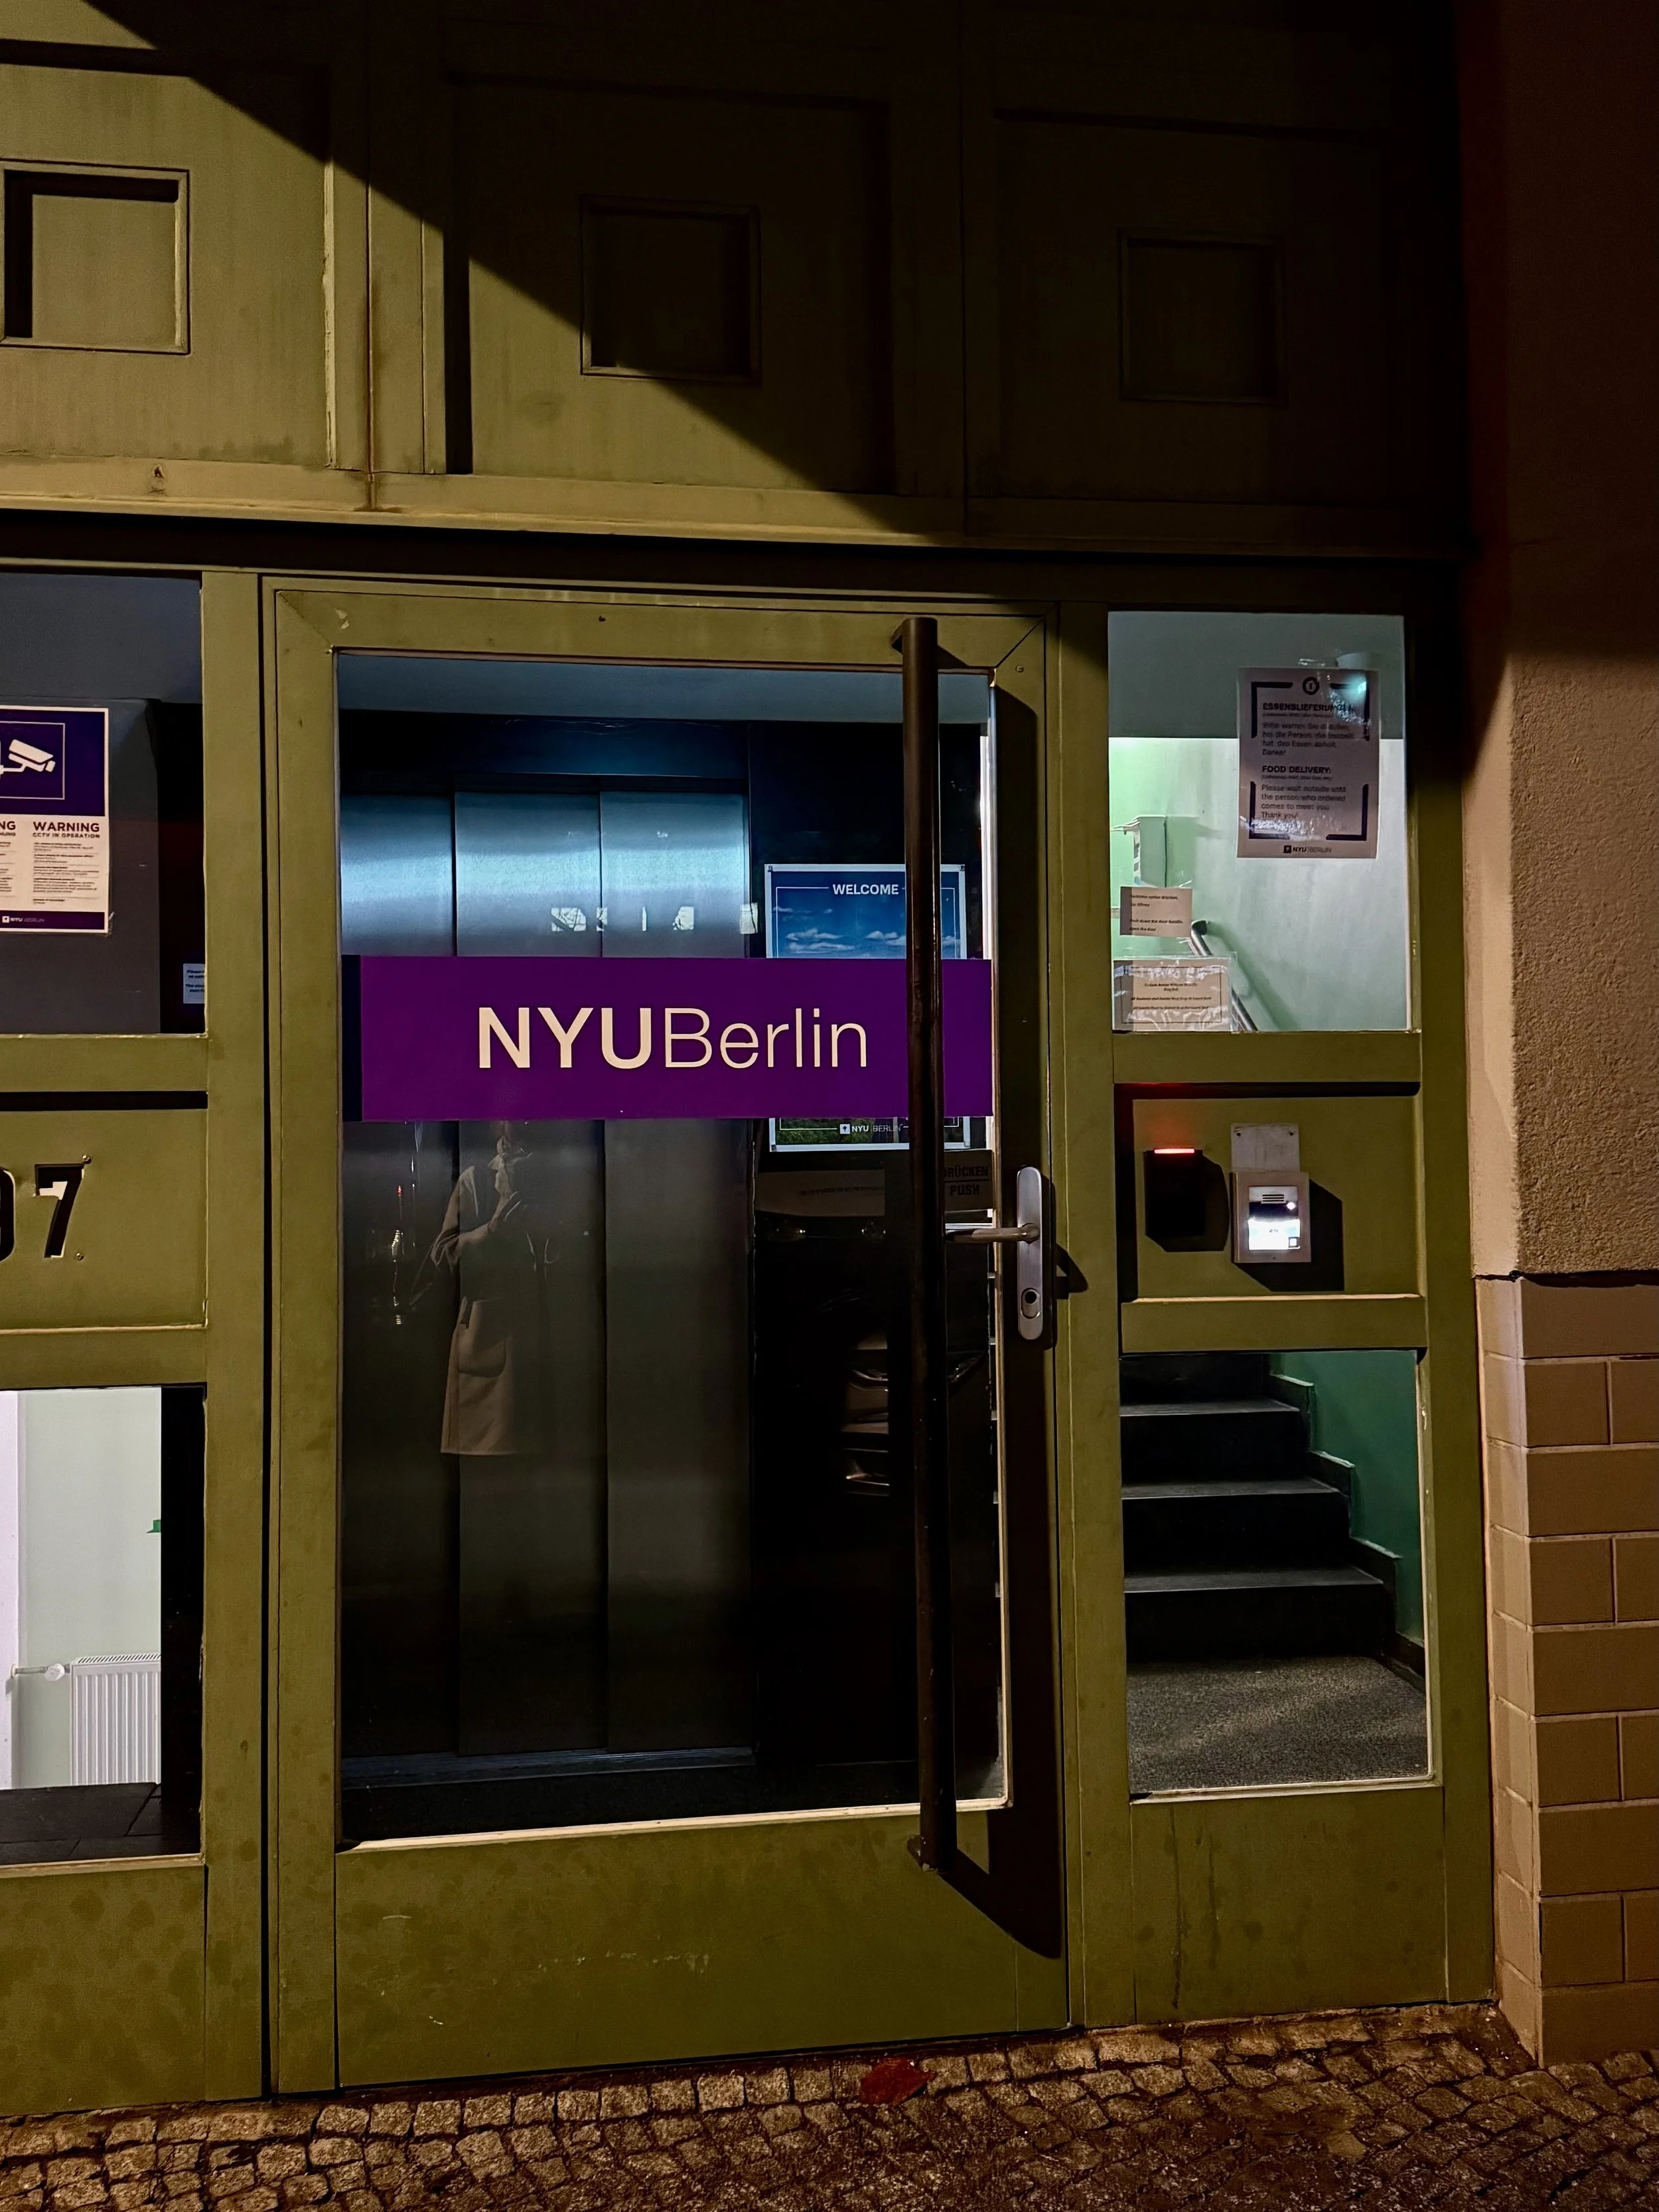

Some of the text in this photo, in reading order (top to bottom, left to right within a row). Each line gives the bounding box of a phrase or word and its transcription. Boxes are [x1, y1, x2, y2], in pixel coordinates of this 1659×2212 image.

[33, 822, 100, 832] WARNING
[833, 884, 899, 895] WELCOME
[478, 1007, 867, 1069] NYUBerlin
[950, 1184, 979, 1196] PUSH
